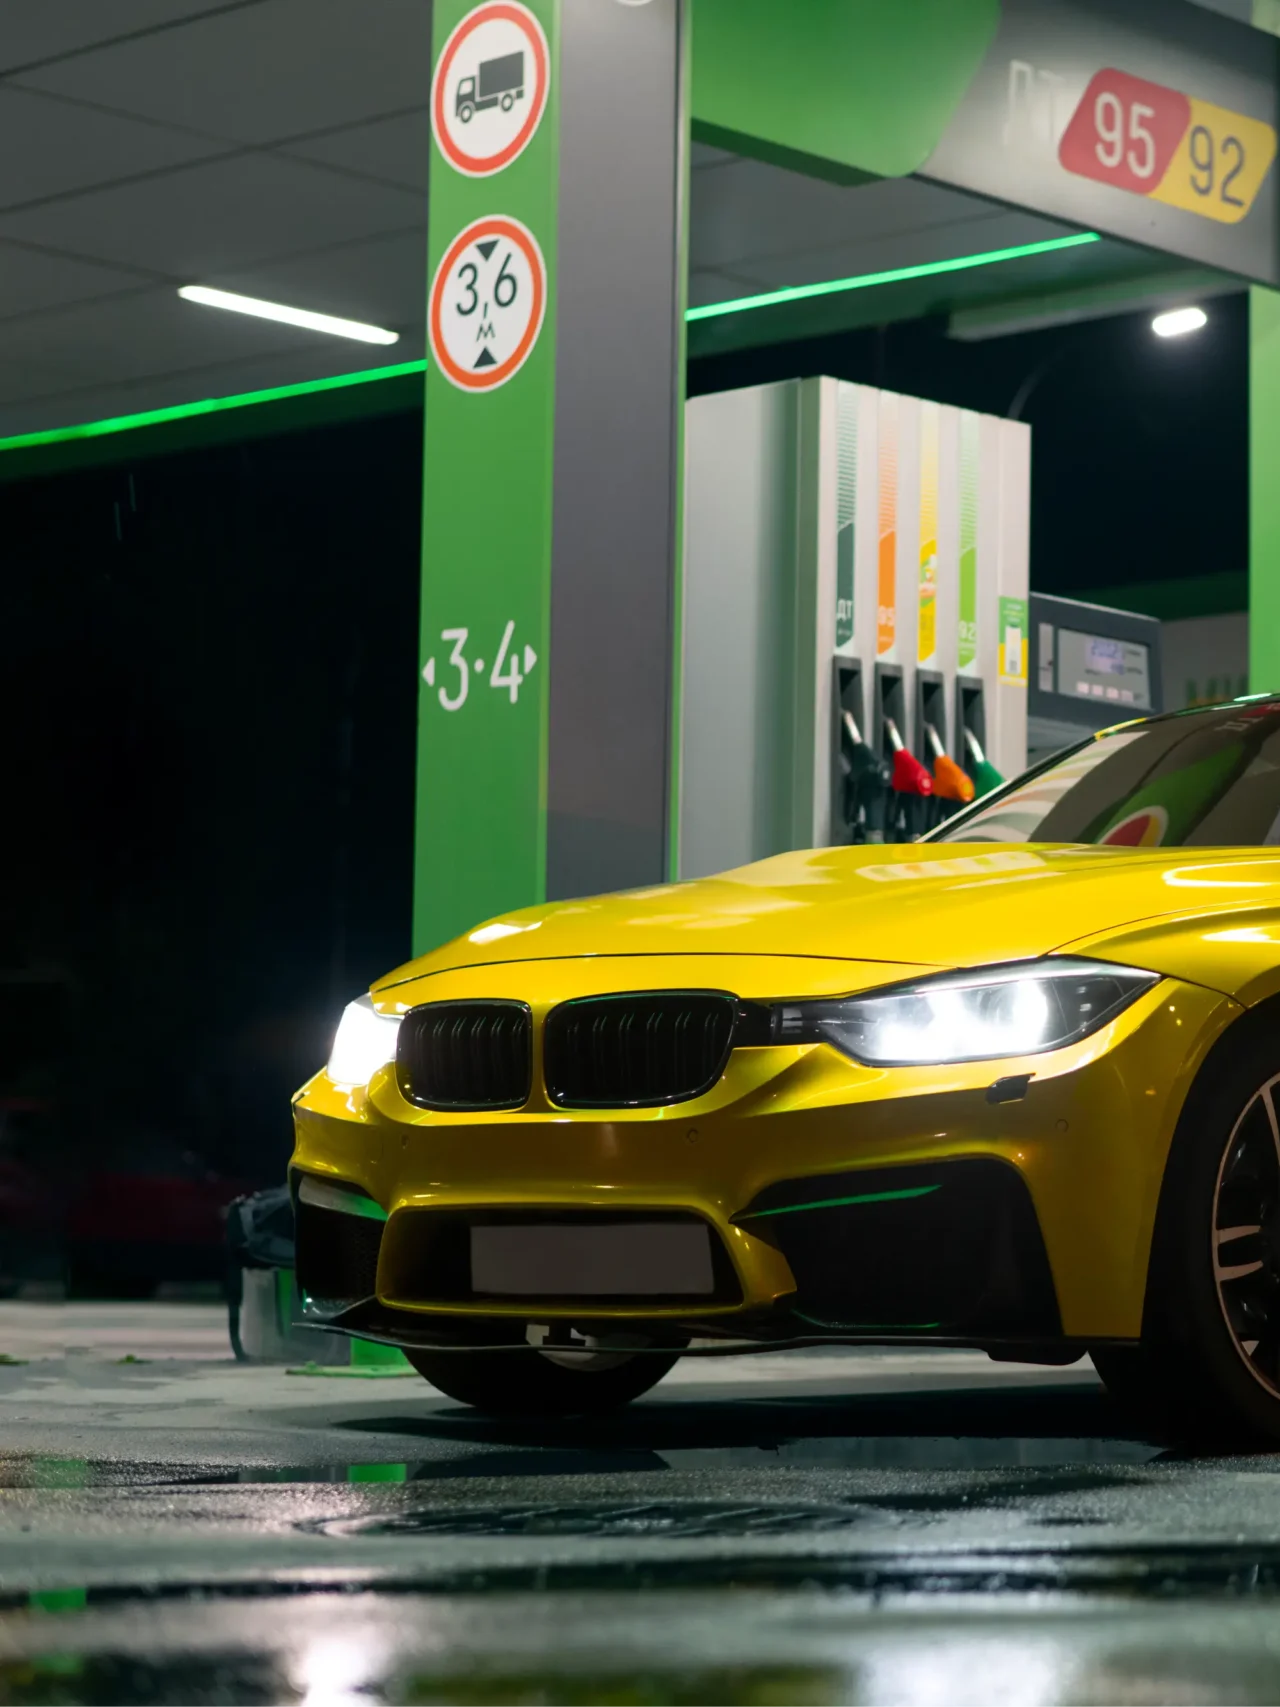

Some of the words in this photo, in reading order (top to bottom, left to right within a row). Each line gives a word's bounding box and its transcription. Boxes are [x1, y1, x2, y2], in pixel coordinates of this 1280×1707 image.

[1094, 92, 1156, 178] 95
[1189, 125, 1246, 208] 92
[456, 252, 518, 320] 3,6
[836, 599, 854, 622] ДТ
[958, 620, 976, 641] 92
